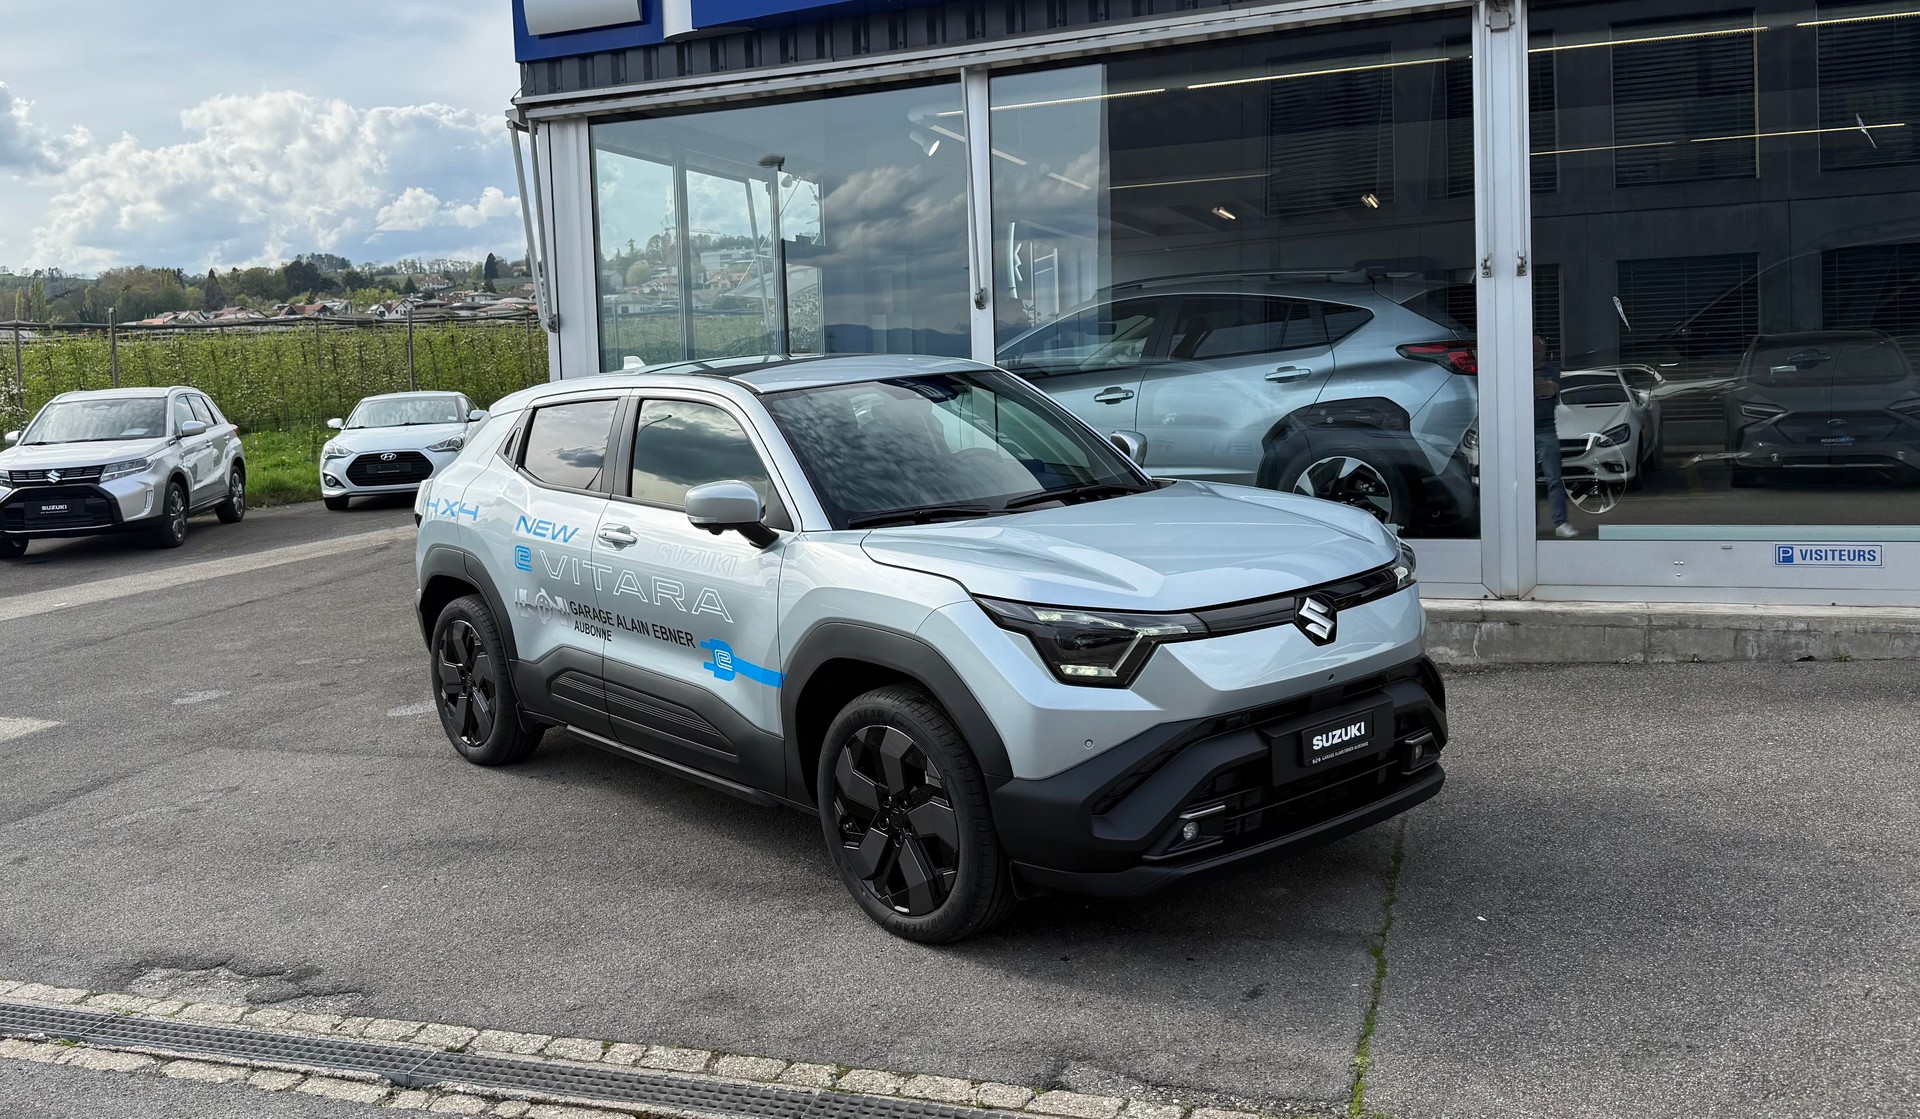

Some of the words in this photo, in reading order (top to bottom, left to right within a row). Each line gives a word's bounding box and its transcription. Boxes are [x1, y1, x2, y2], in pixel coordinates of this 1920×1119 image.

[515, 514, 580, 543] NEW
[654, 542, 739, 578] SUZUKI
[1779, 547, 1793, 562] P
[1799, 548, 1877, 562] VISITEURS
[539, 549, 735, 624] VITARA
[569, 600, 615, 627] GARAGE
[616, 614, 650, 637] ALAIN
[651, 623, 697, 649] EBNER
[573, 620, 613, 643] AUBONNE
[831, 709, 885, 746] GOODYEAR
[1312, 721, 1365, 750] SUZUKI
